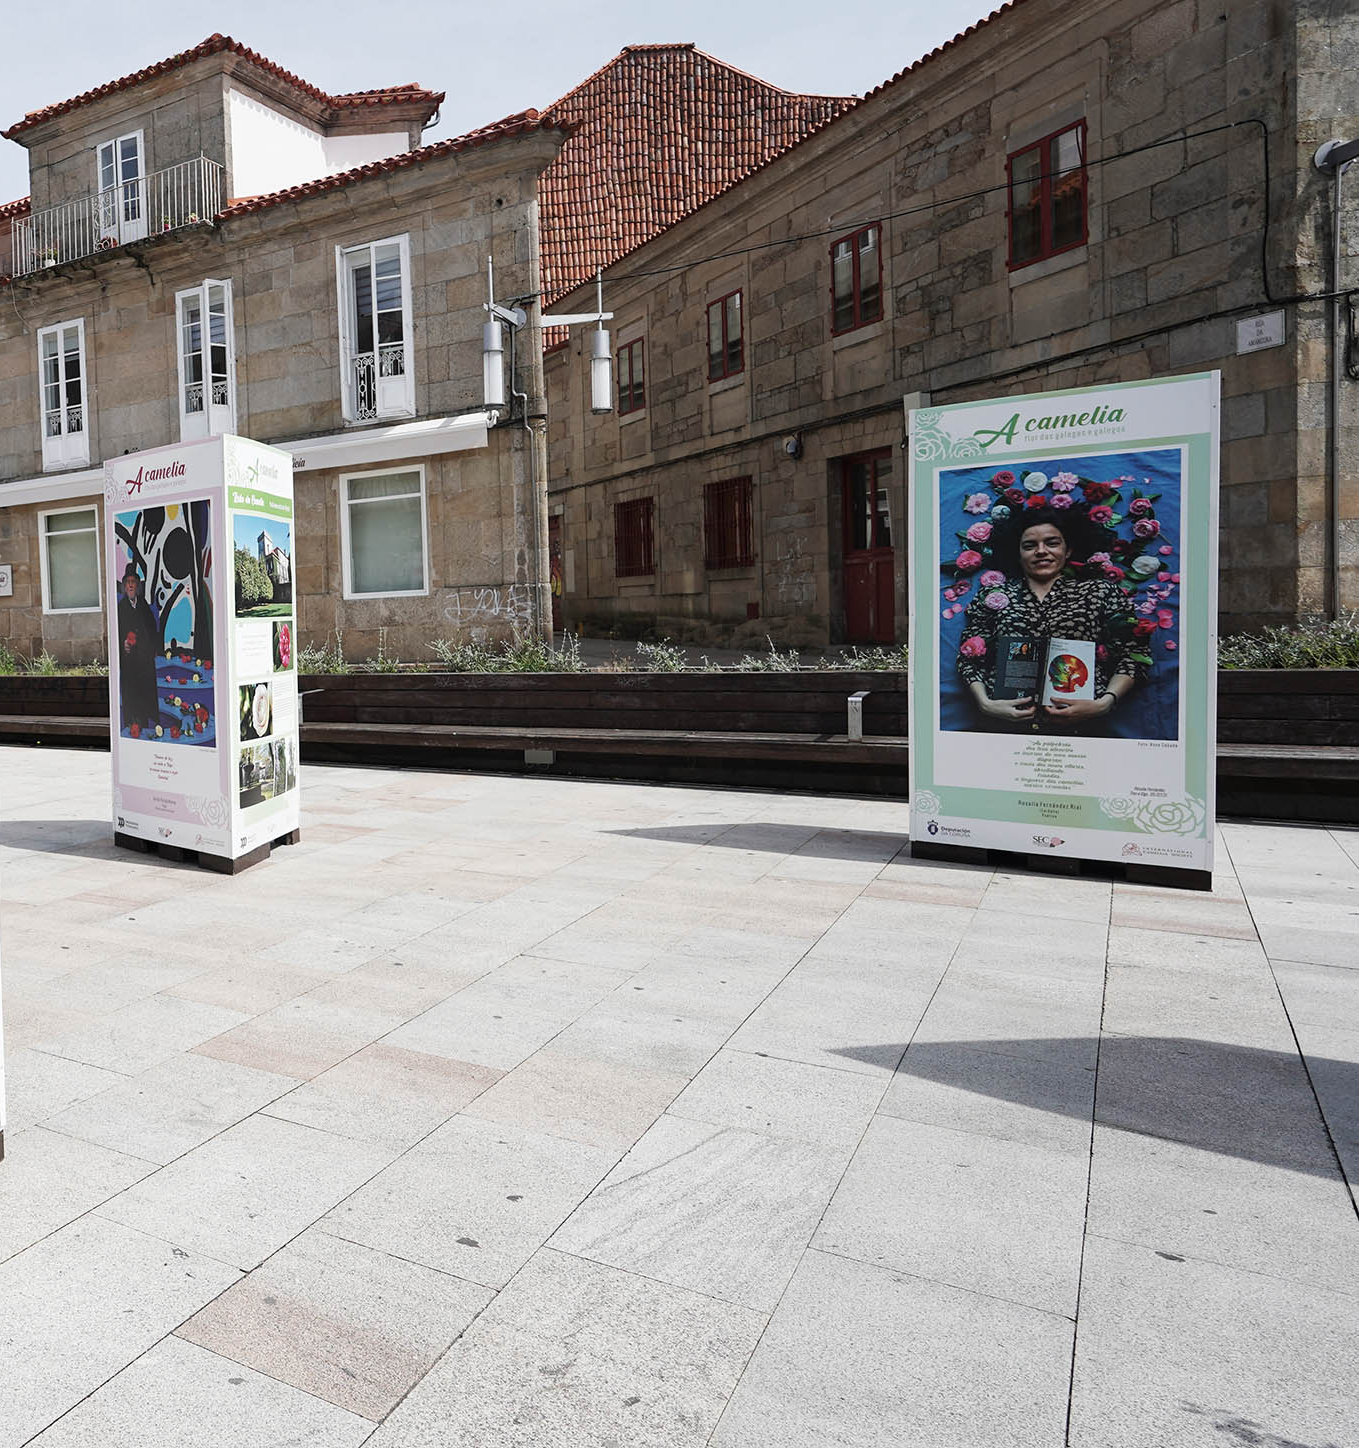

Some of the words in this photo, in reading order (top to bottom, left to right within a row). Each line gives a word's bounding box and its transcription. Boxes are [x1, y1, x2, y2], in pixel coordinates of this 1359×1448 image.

[973, 412, 1020, 449] A
[1024, 405, 1128, 432] camelia
[125, 466, 143, 495] A
[145, 461, 187, 482] camelia
